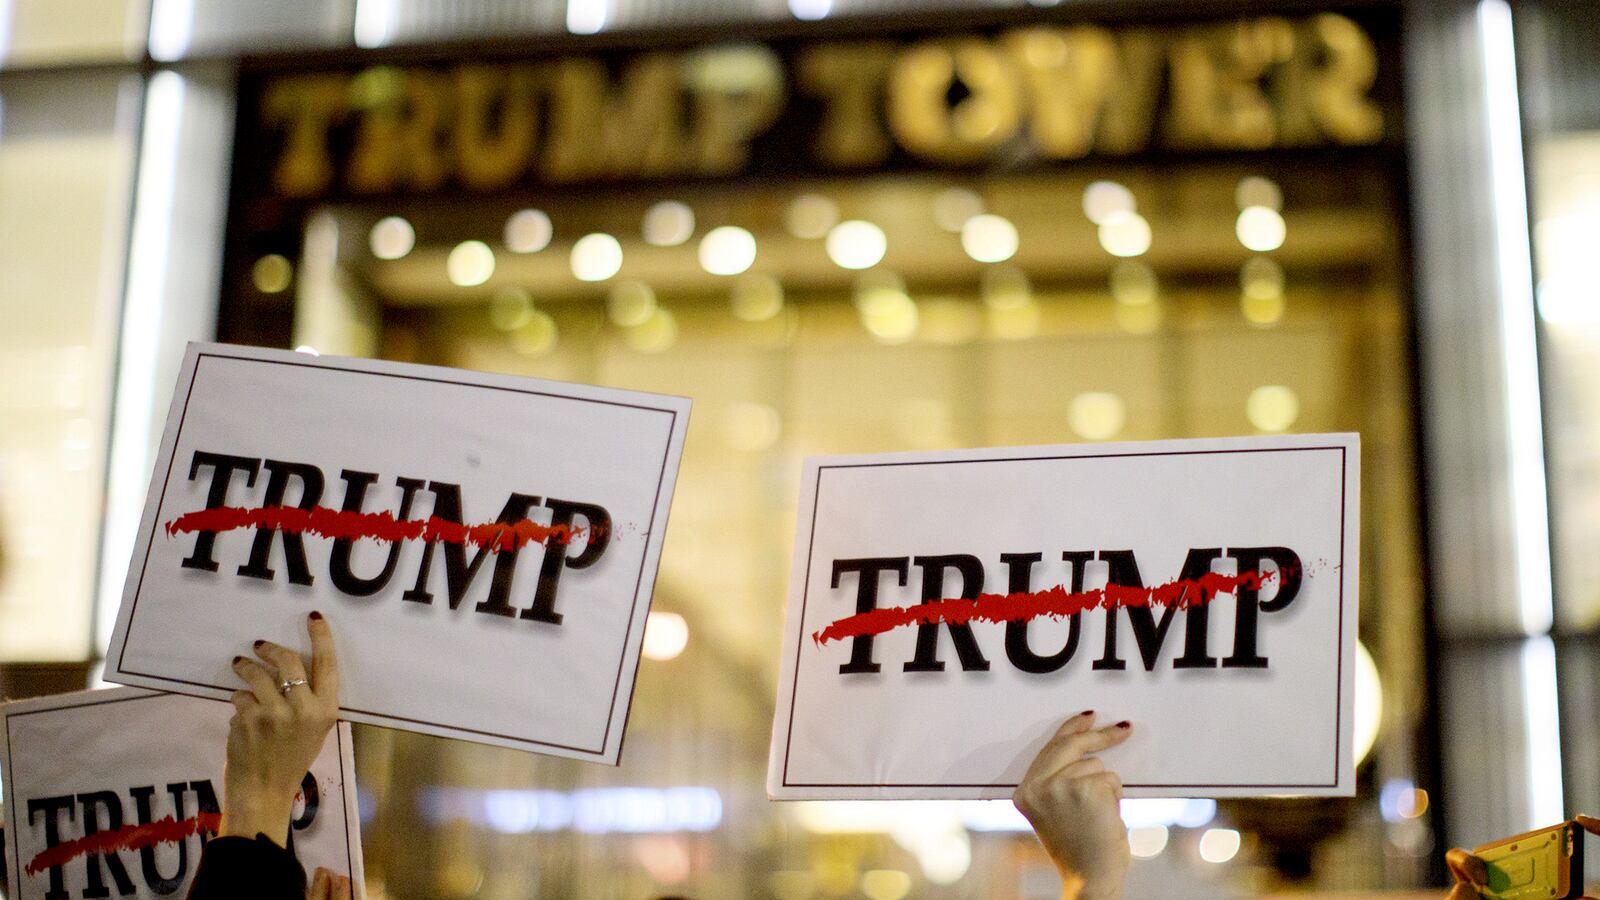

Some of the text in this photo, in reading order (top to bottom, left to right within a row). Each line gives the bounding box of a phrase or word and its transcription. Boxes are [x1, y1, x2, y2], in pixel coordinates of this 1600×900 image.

[260, 13, 1383, 196] TRUMP TOWER
[181, 450, 613, 626] TRUMP
[830, 546, 1302, 675] TRUMP
